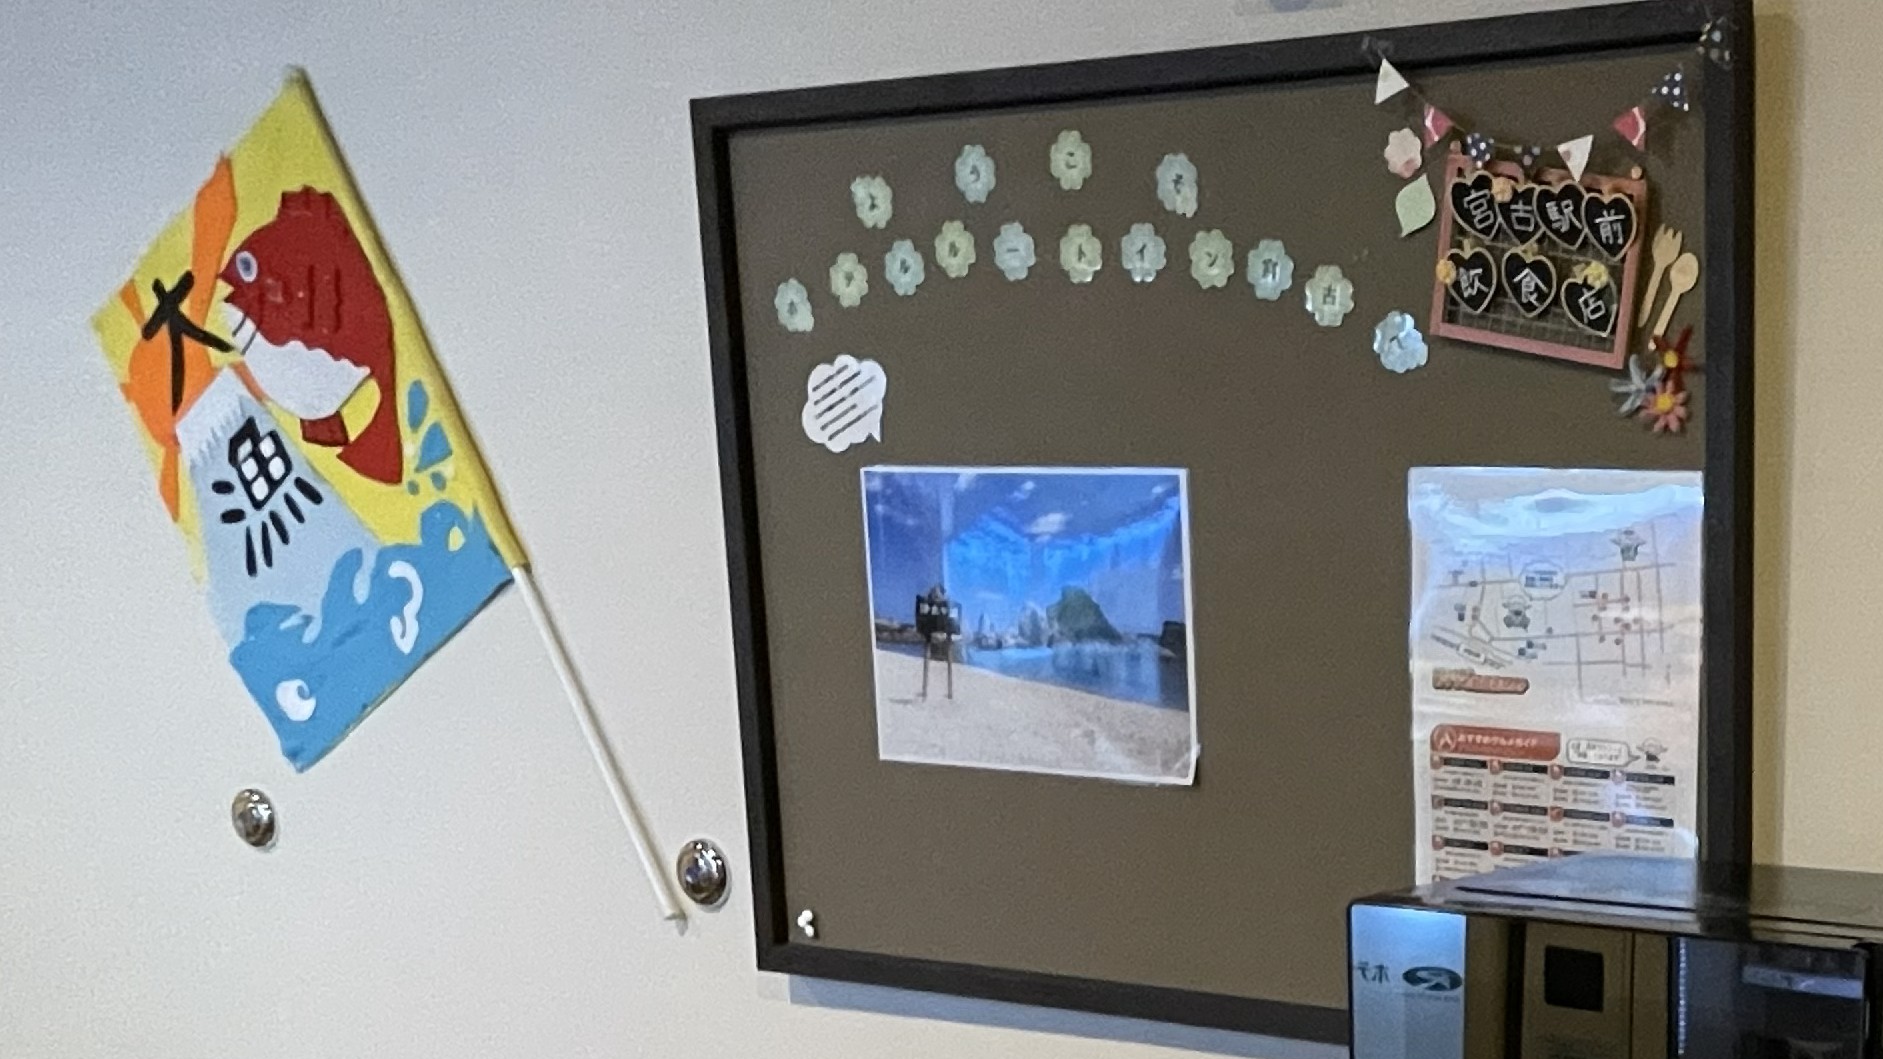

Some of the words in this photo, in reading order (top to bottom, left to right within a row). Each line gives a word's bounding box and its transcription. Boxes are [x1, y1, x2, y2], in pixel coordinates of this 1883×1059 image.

[1462, 188, 1626, 246] 宮古駅前
[1458, 266, 1605, 322] 飲食店
